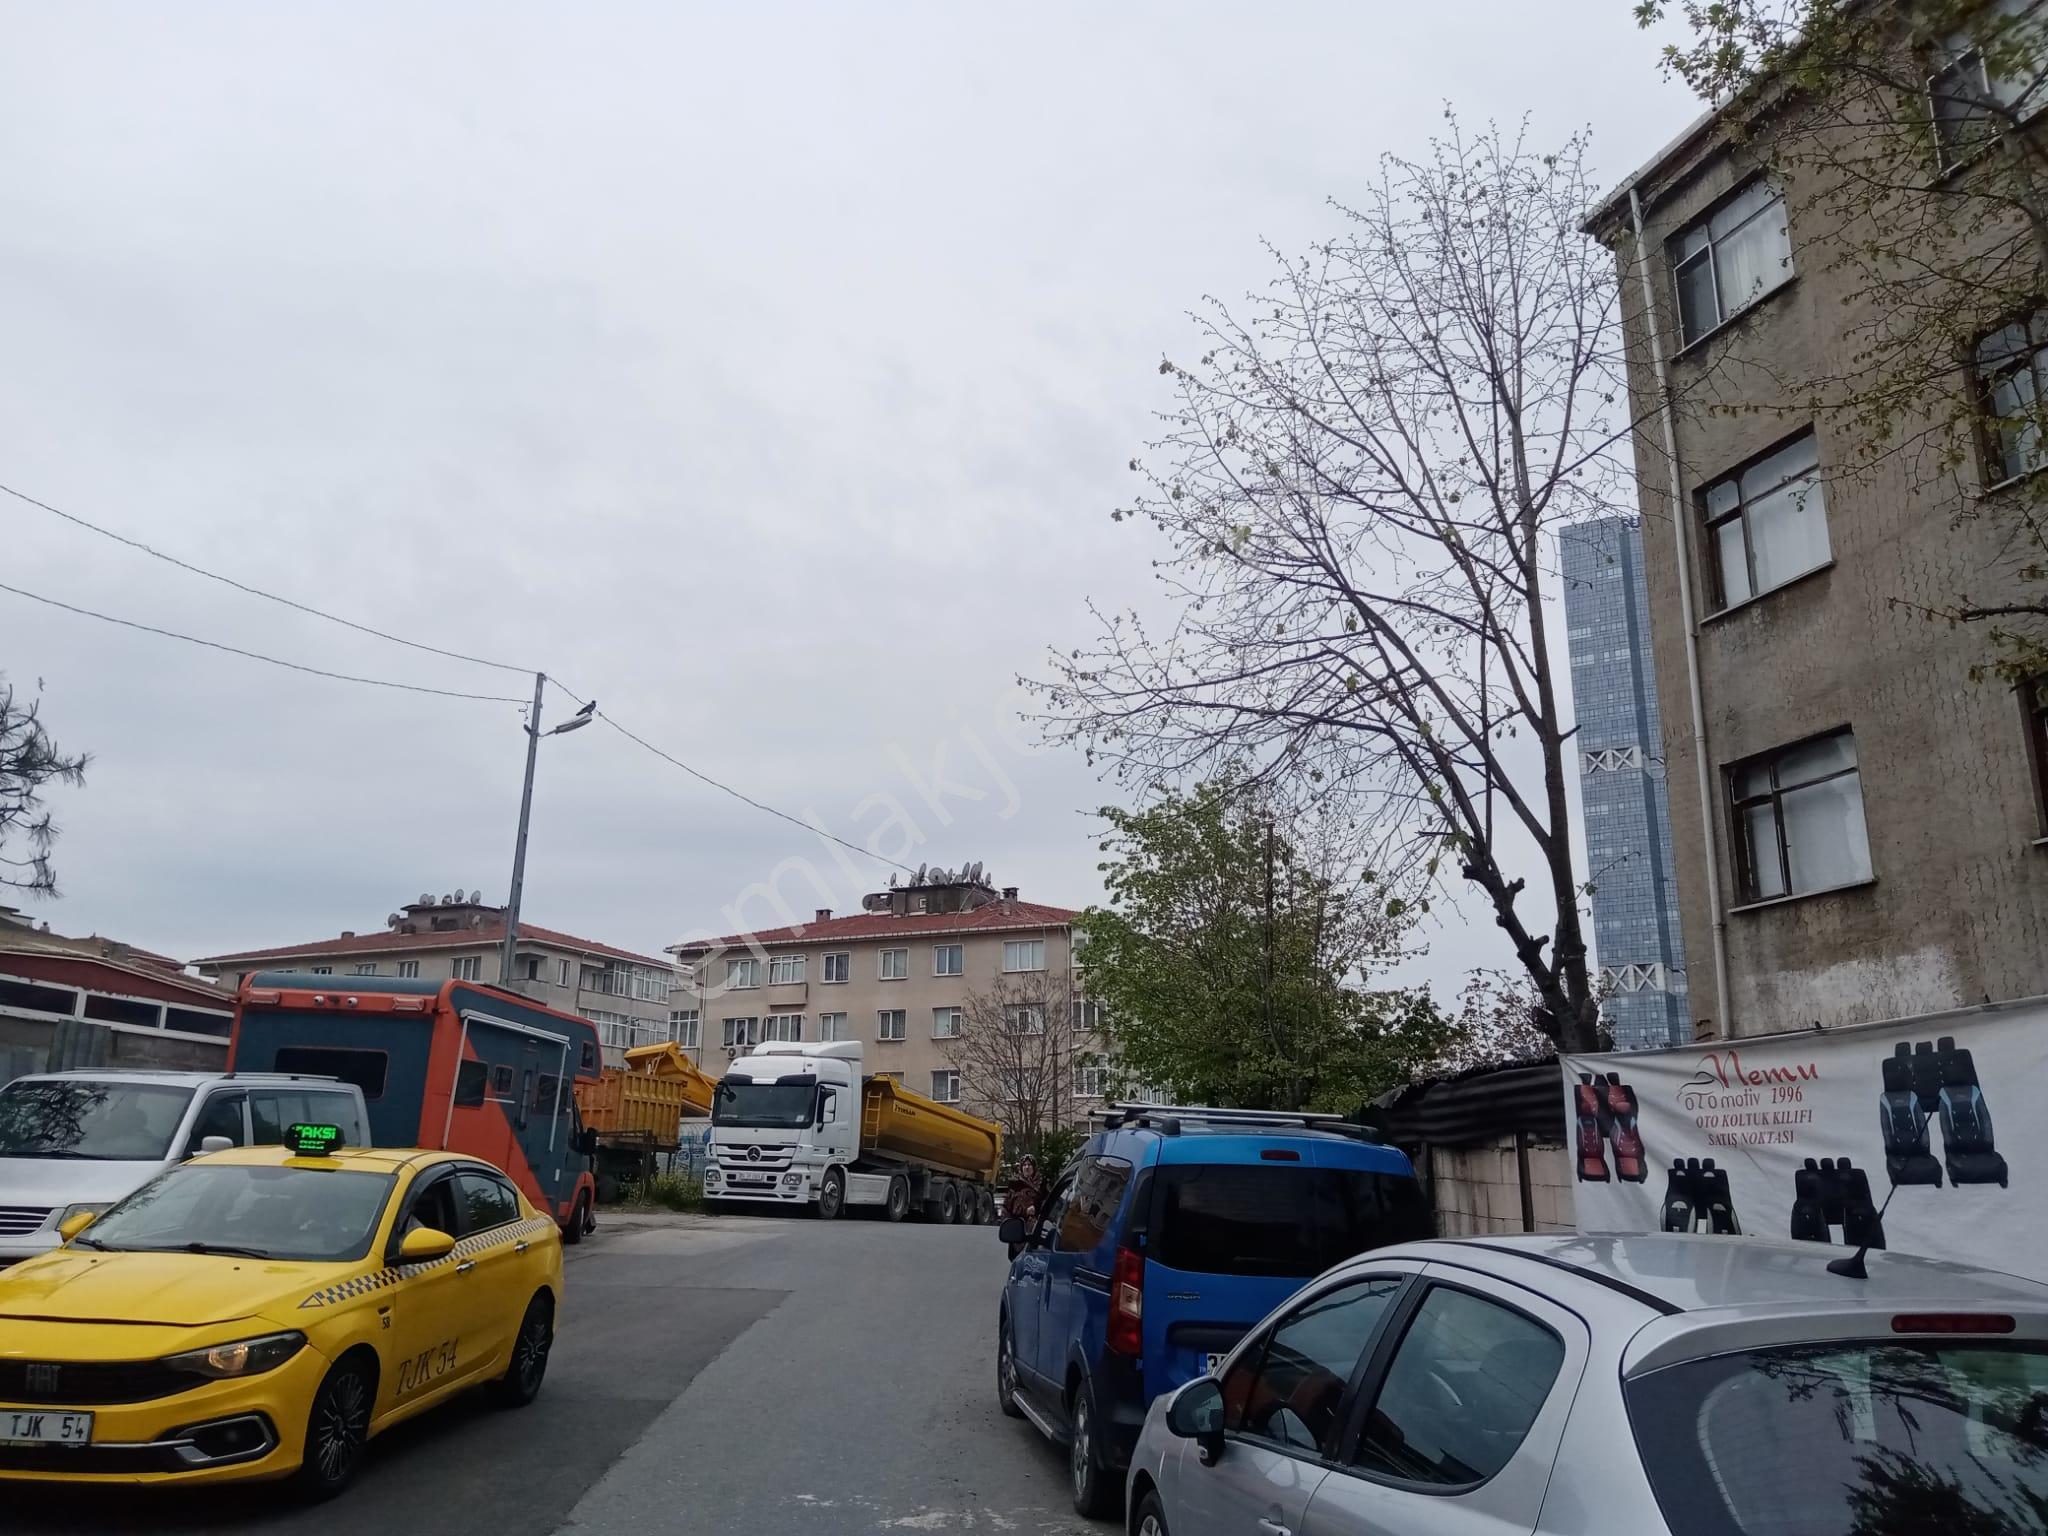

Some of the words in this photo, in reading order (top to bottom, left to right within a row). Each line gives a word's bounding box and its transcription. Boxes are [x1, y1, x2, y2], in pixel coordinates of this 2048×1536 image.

[1697, 1050, 1819, 1088] Nemu
[1772, 1086, 1803, 1104] 1996
[1696, 1115, 1719, 1129] OTO
[1722, 1111, 1770, 1128] KOLTUK
[1773, 1109, 1813, 1125] KILIFI
[1708, 1132, 1738, 1148] SATIŞ
[1741, 1130, 1794, 1145] NOKTASI
[396, 1347, 437, 1395] TJK
[436, 1336, 459, 1375] 54
[11, 1414, 45, 1438] TJK
[61, 1416, 84, 1439] 54
